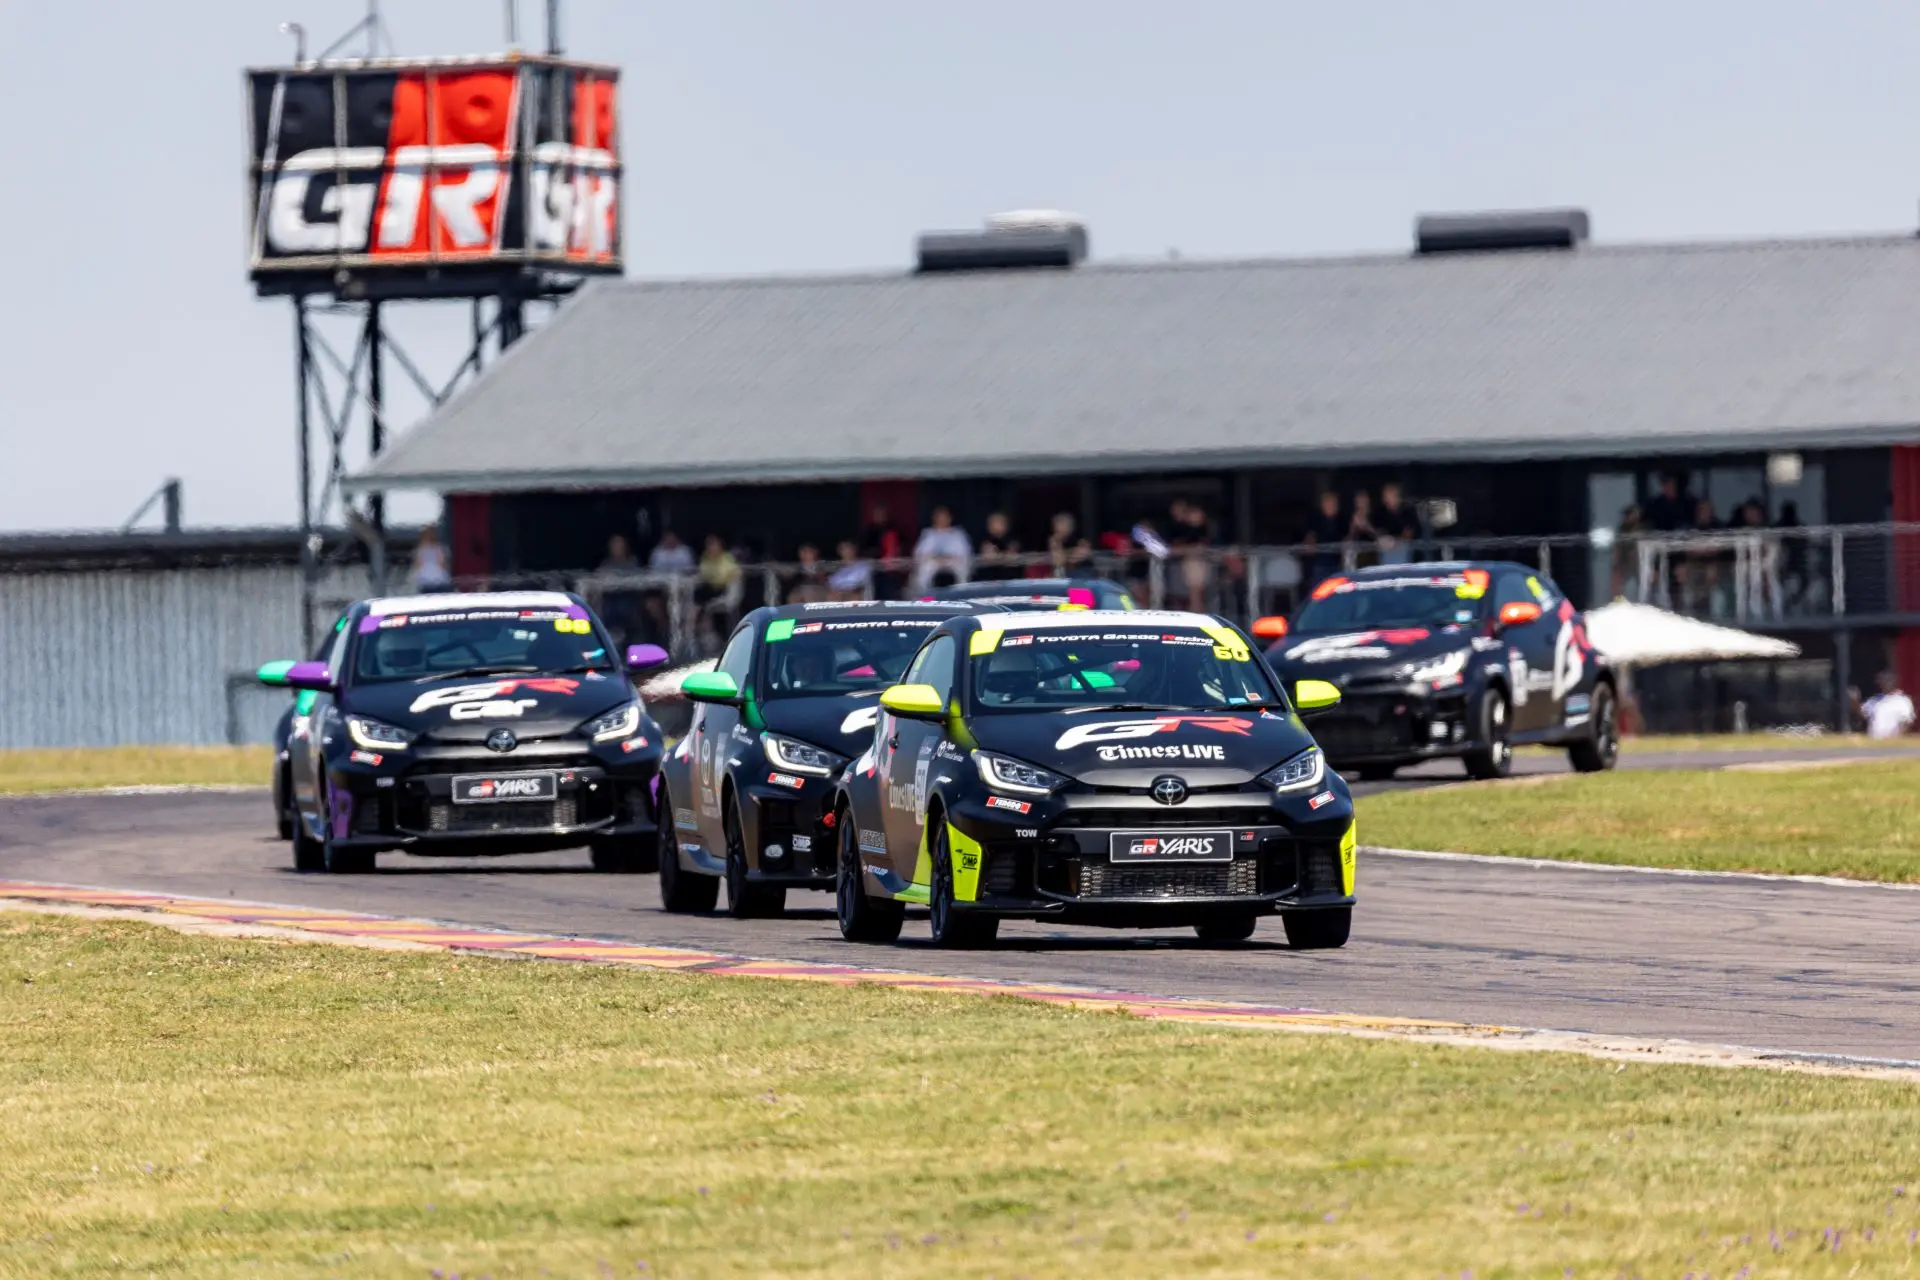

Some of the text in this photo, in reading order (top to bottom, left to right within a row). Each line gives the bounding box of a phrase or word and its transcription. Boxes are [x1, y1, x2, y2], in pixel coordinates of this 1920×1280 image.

[267, 142, 501, 253] GR
[825, 621, 889, 631] TOYOTA
[1036, 634, 1100, 643] TOYOTA
[1102, 633, 1160, 642] GAZOO
[409, 677, 580, 713] GR
[450, 699, 538, 720] car
[1055, 715, 1254, 750] GR
[494, 777, 541, 796] YARIS
[1015, 828, 1038, 838] TOW
[1130, 837, 1215, 855] GR YARIS
